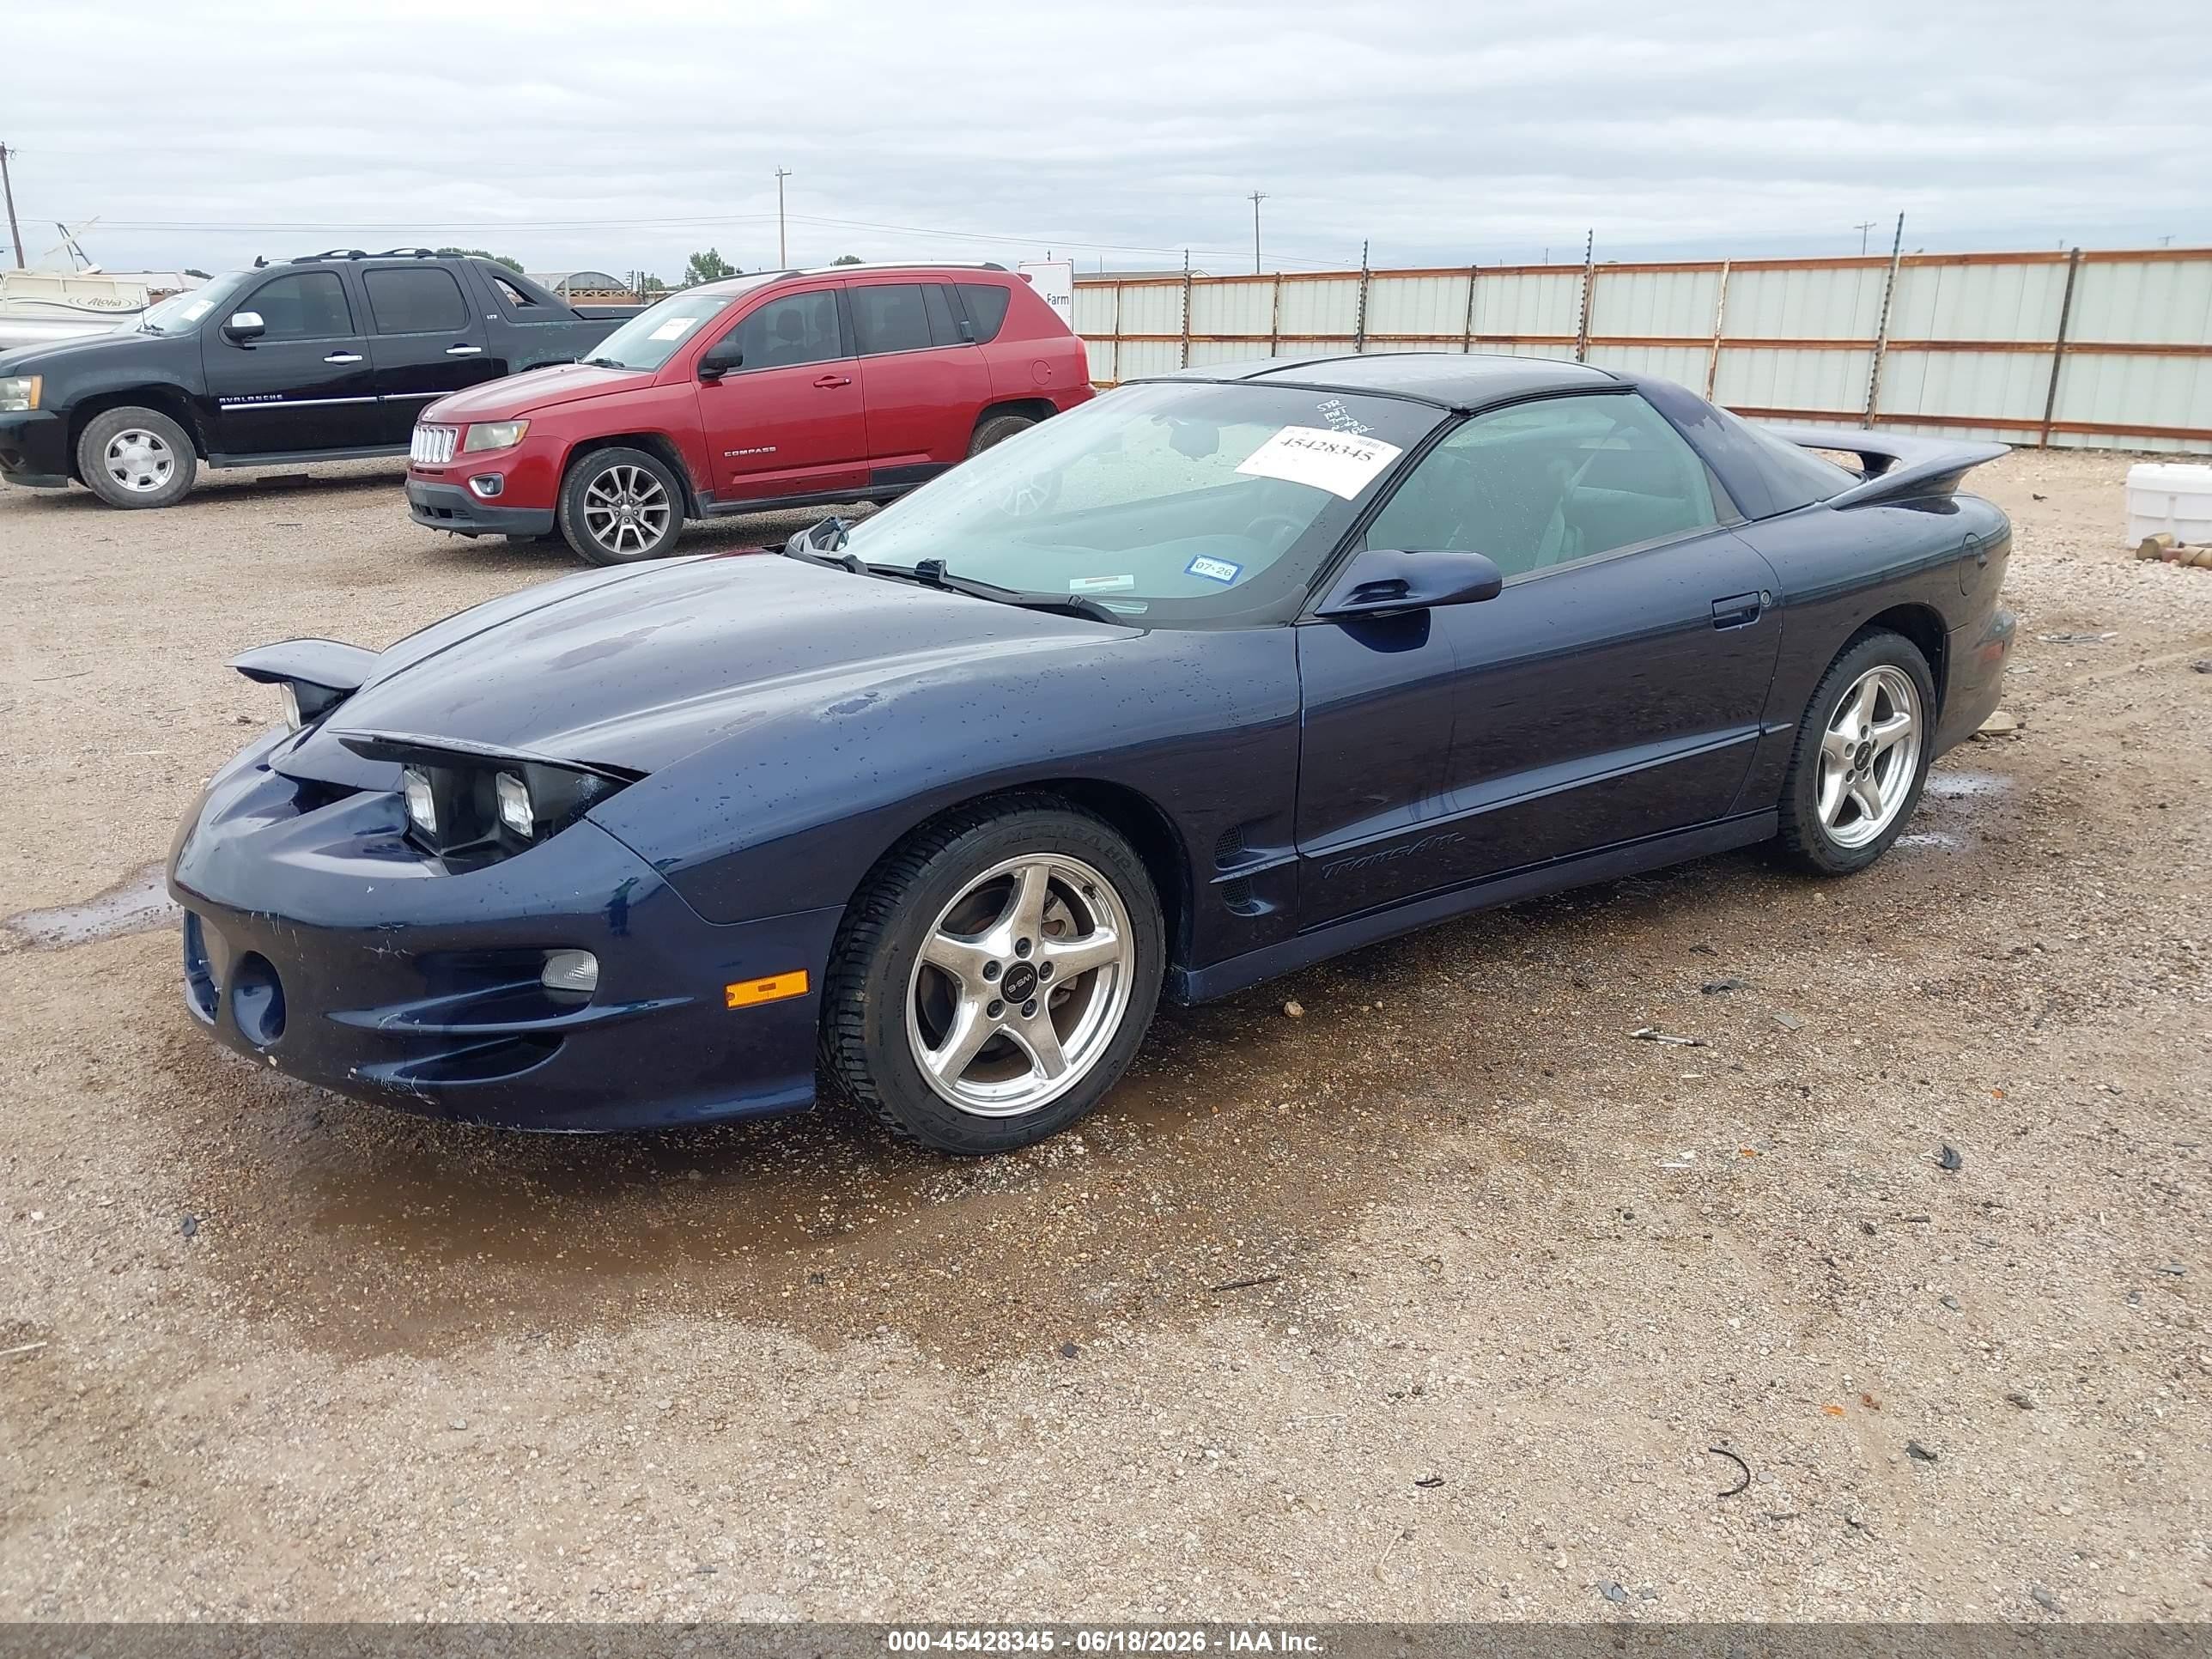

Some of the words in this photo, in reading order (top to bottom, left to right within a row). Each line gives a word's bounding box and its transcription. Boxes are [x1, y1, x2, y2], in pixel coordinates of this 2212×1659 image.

[1047, 293, 1069, 306] Farm
[219, 394, 283, 404] AVALANCHE
[724, 447, 776, 457] COMPASS
[1279, 438, 1376, 462] 45428345
